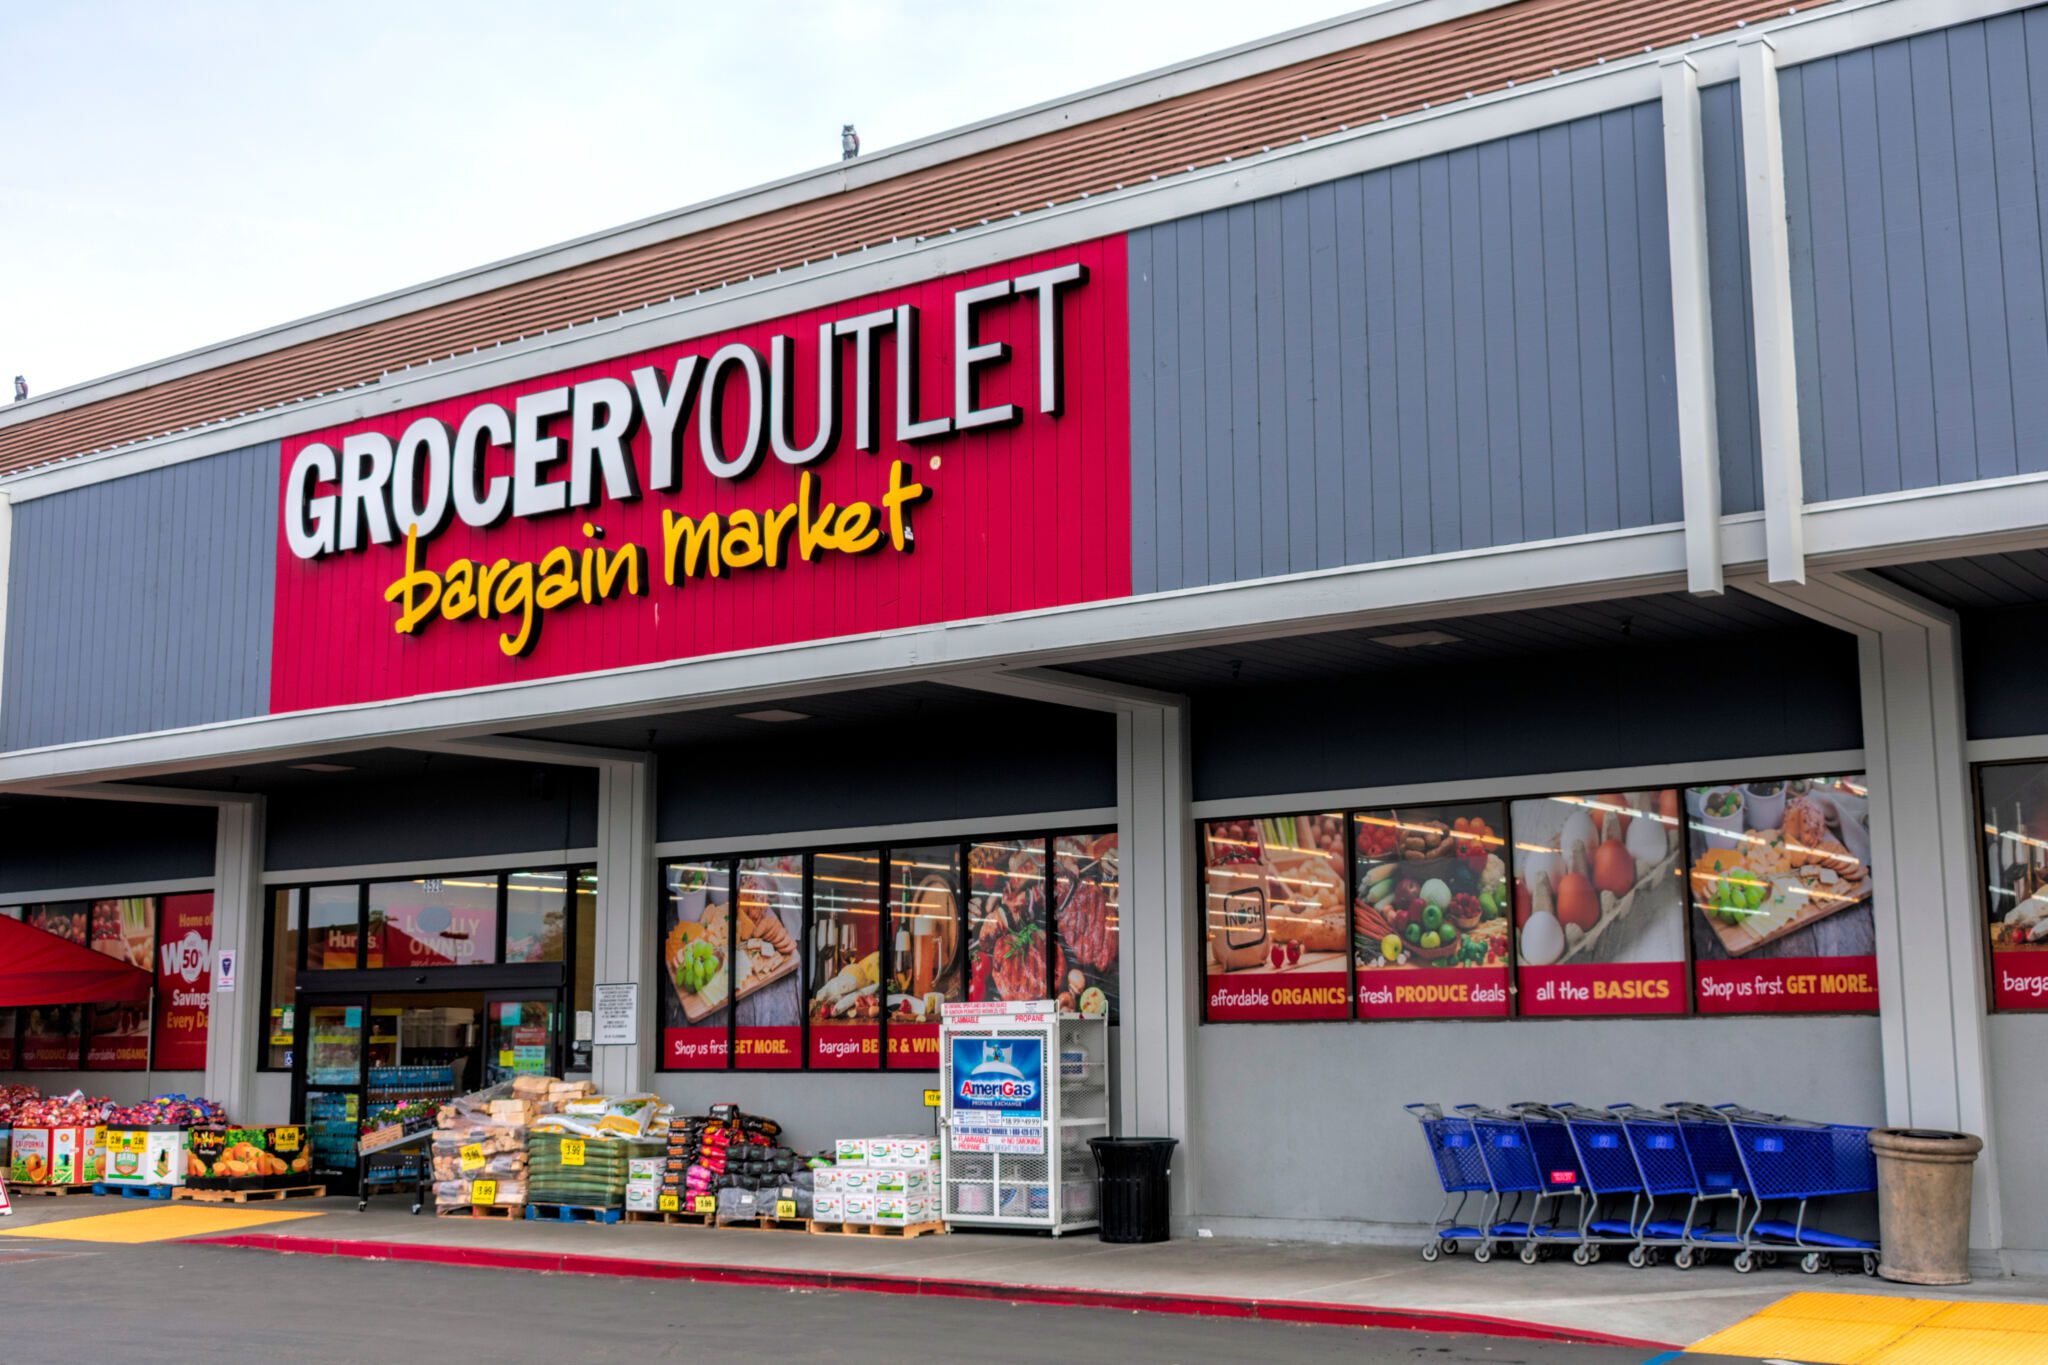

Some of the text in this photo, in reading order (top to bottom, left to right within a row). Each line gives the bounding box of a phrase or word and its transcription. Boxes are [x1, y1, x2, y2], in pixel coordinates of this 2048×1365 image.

[384, 459, 922, 656] bargain market
[179, 913, 203, 928] Home
[410, 938, 474, 956] OWNED
[183, 949, 199, 969] 50
[1211, 987, 1345, 1007] affordable ORGANICS
[1359, 984, 1506, 1004] fresh PRODUCE deals
[1536, 979, 1669, 1000] all the BASICS
[1701, 978, 1733, 1000] Shop
[1736, 983, 1752, 997] us
[1786, 975, 1818, 995] GET
[167, 1011, 195, 1032] Every
[1015, 1014, 1044, 1022] PROPANE
[674, 1040, 697, 1058] Shop
[698, 1042, 708, 1055] us
[734, 1039, 752, 1054] GET
[819, 1038, 860, 1058] bargain
[900, 1038, 910, 1053] &
[962, 1081, 1031, 1096] AmeriGas
